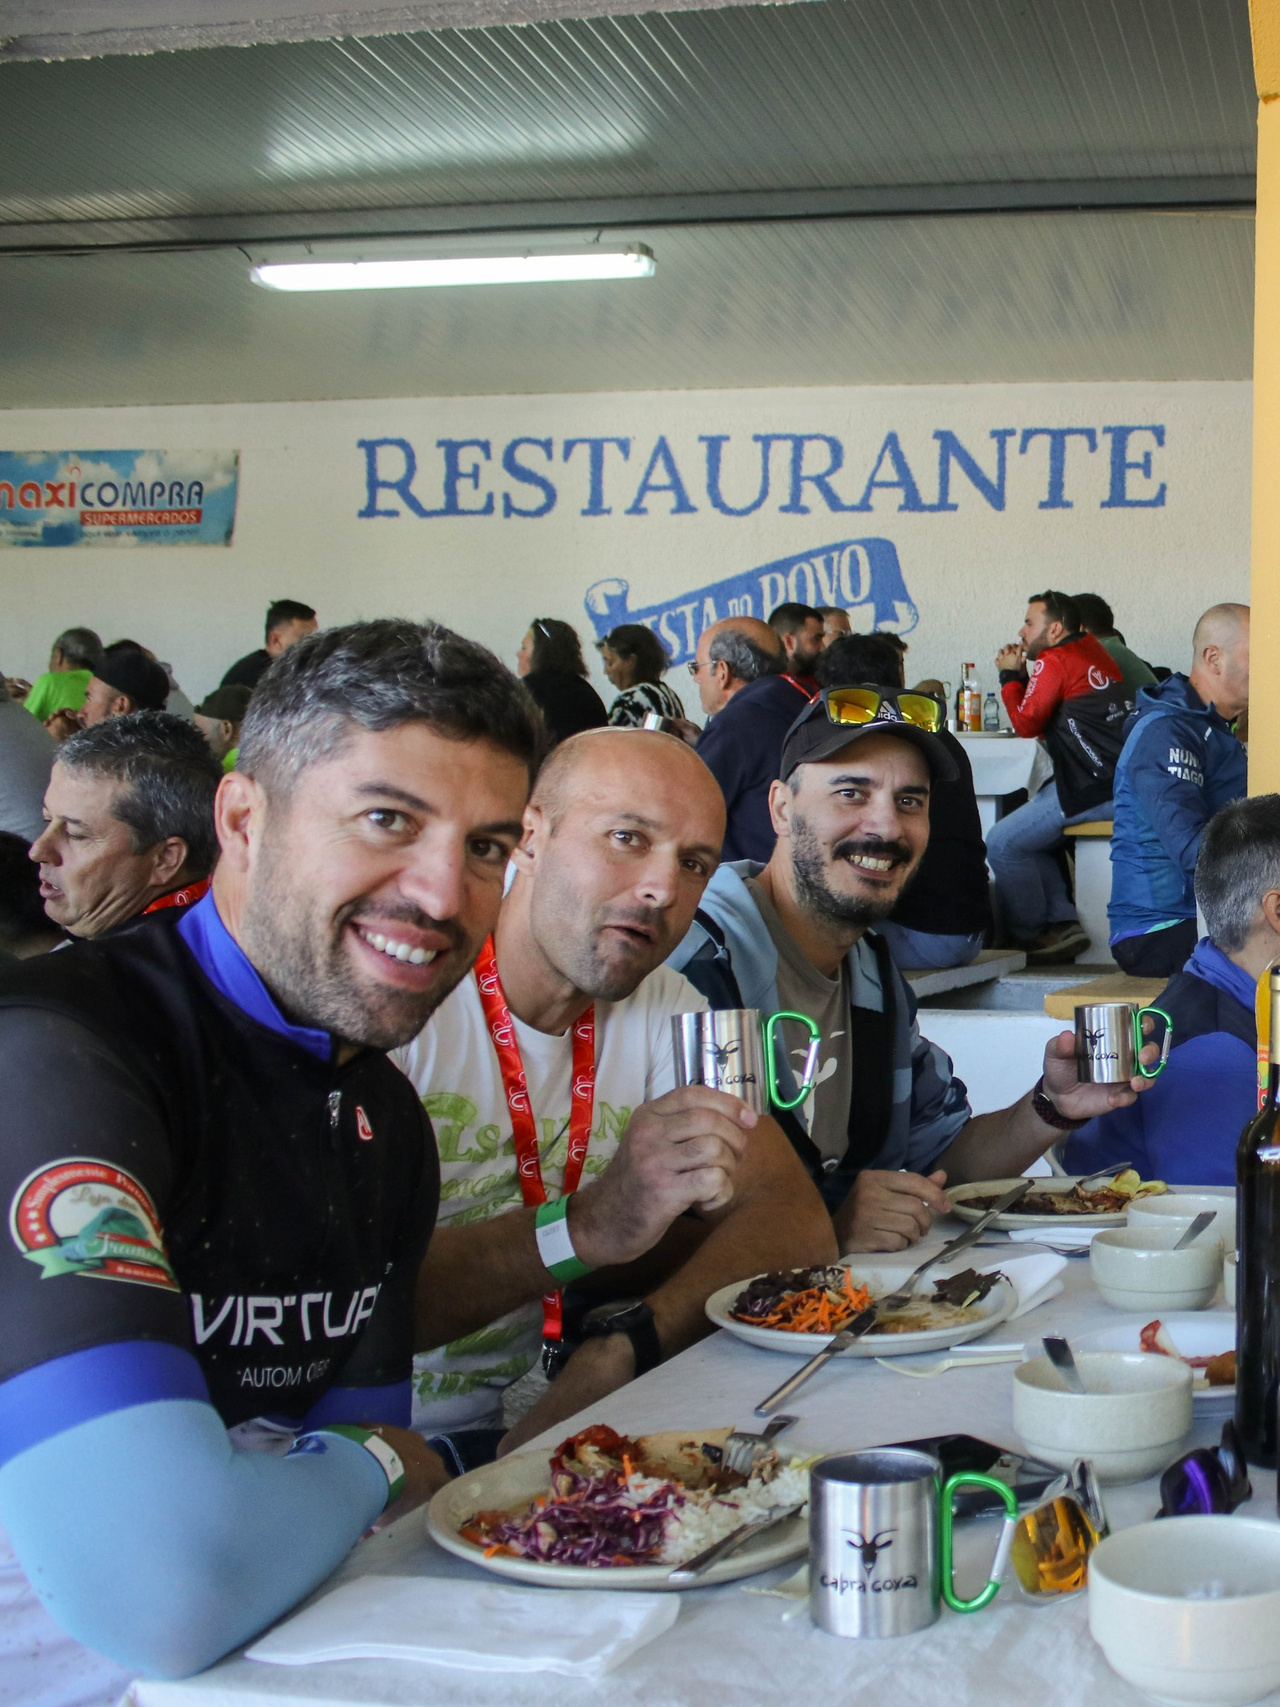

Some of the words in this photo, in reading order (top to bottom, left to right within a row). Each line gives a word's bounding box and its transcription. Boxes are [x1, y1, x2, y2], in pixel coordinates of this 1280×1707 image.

[357, 424, 1167, 518] RESTAURANTE
[84, 510, 197, 525] SUPERMERCADOS
[758, 544, 871, 620] POVO
[1167, 766, 1204, 788] TIAGO
[820, 1573, 863, 1595] capra
